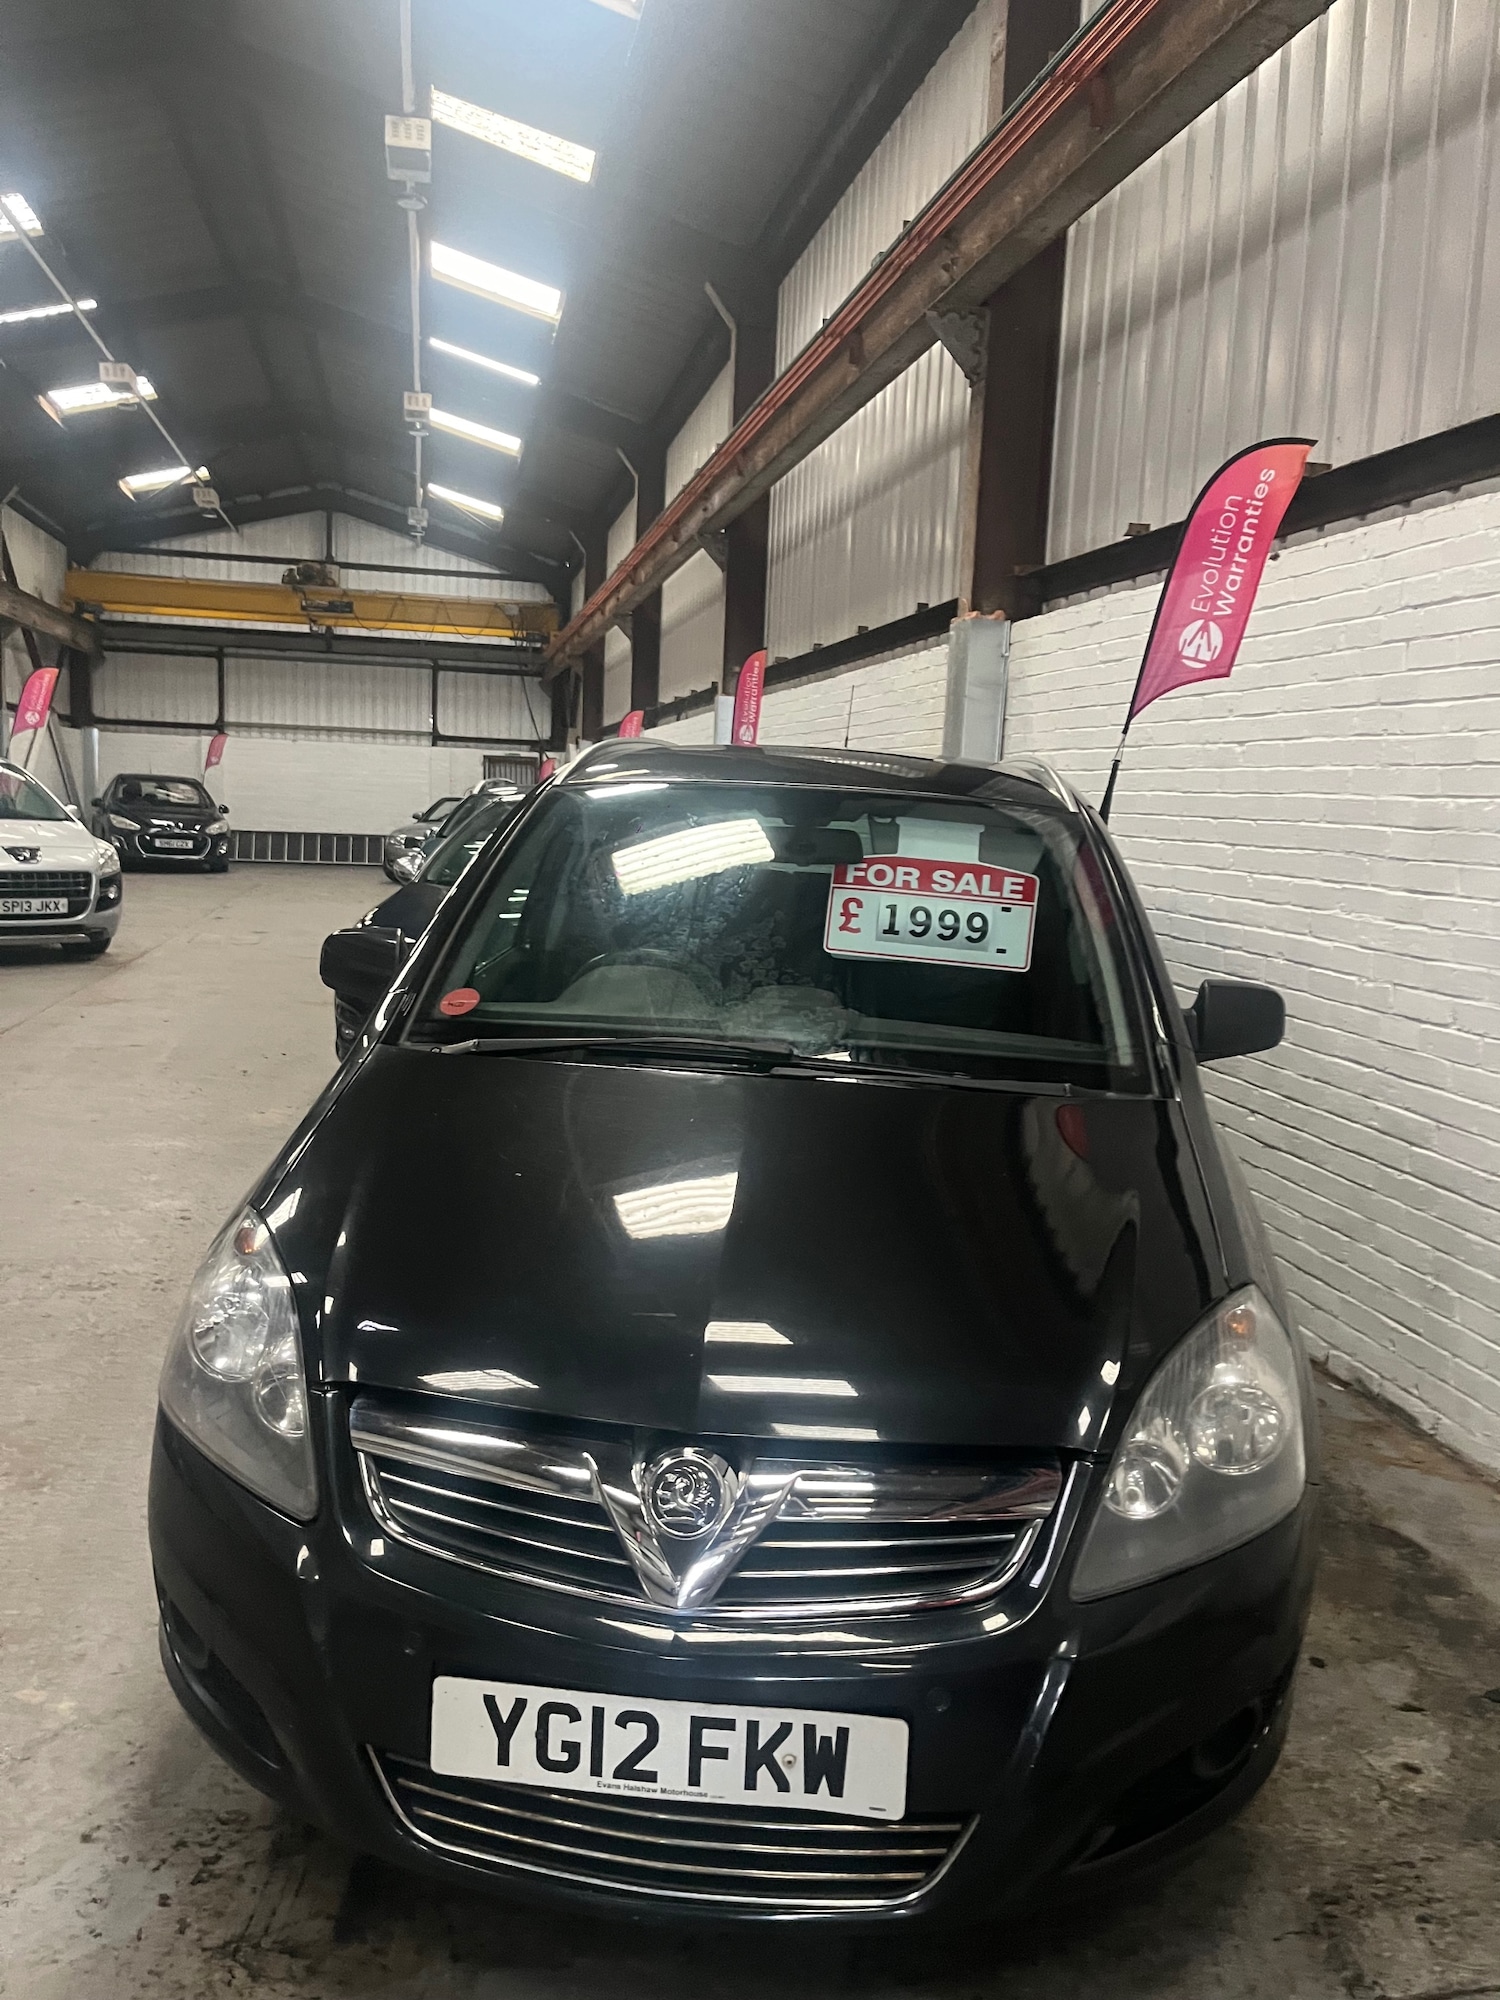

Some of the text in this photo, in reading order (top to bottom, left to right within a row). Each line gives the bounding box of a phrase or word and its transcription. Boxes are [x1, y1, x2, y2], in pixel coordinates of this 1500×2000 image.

[1190, 494, 1244, 614] Evolution
[1212, 467, 1276, 616] Warranties
[845, 863, 1026, 900] FOR SALE
[2, 900, 61, 912] SP13 JKX
[838, 897, 989, 944] £ 1999
[483, 1694, 850, 1798] YG12 FKW
[597, 1780, 621, 1790] Evans
[623, 1783, 658, 1794] Halshaw
[660, 1786, 709, 1799] Motorhouse
